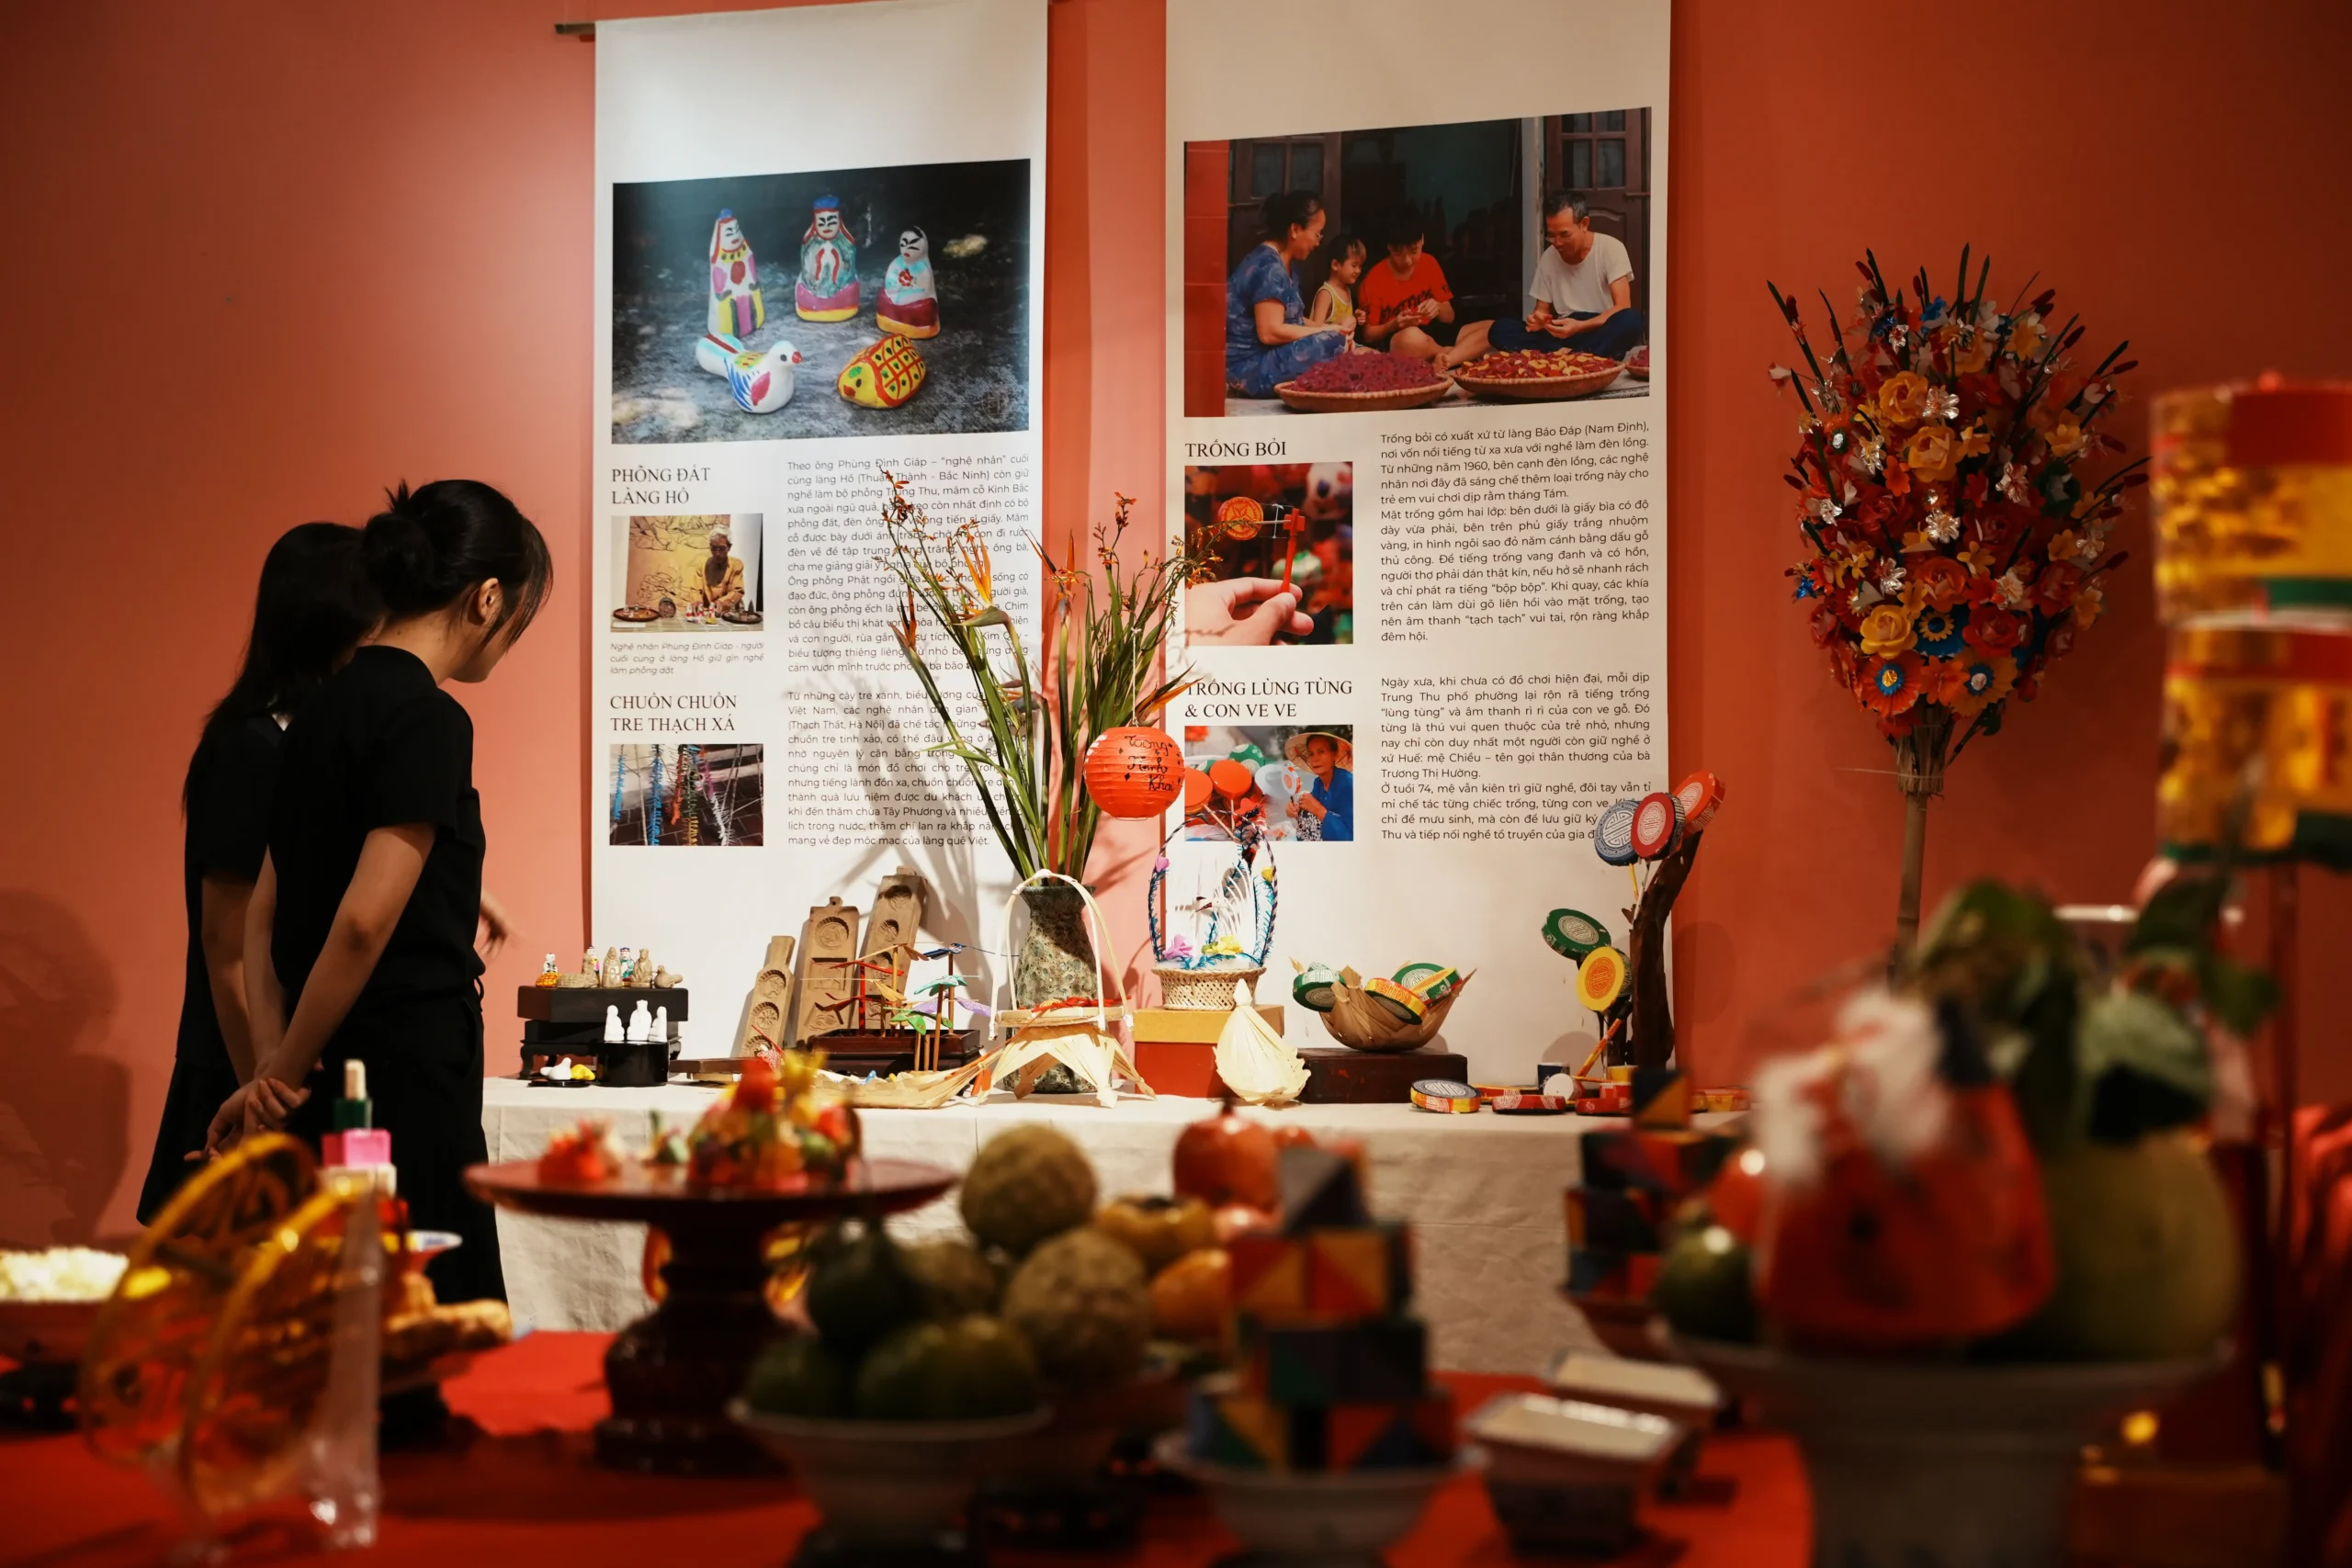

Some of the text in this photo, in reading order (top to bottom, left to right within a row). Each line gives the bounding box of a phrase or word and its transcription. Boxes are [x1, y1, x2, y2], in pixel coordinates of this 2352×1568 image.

[1380, 421, 1648, 445] Trống bỏi có xuất xứ từ làng Báo Đáp (Nam Định),
[1185, 437, 1286, 457] TRỐNG BỎI
[1381, 436, 1648, 458] nơi vốn nổi tiếng từ xa xưa với nghề làm đèn lồng.
[787, 461, 811, 470] Theo
[815, 461, 833, 471] ông
[838, 459, 871, 470] Phùng
[903, 457, 927, 468] Giáp
[1010, 454, 1029, 464] cuối
[1380, 452, 1648, 475] Từ những năm 1960, bên cạnh đèn lồng, các nghệ
[1381, 468, 1648, 489] nhân nơi đây đã sáng chế thêm loại trống này cho
[612, 487, 660, 504] LÀNG
[1380, 493, 1396, 504] trẻ
[1419, 492, 1434, 502] vui
[1437, 492, 1460, 502] chơi
[1463, 491, 1480, 503] dịp
[1484, 490, 1505, 501] rằm
[1508, 490, 1540, 501] tháng
[1544, 488, 1568, 498] Tám.
[1382, 608, 1649, 626] nên âm thanh “tạch tạch” vui tai, rộn ràng khắp
[1381, 631, 1428, 642] đêm hội.
[1185, 677, 1352, 696] TRỐNG LÙNG TÙNG
[1382, 671, 1649, 689] Ngày xưa, khi chưa có đồ chơi hiện đại, mỗi dịp
[610, 693, 736, 710] CHUỒN CHUỒN
[1381, 687, 1649, 704] Trung Thu phố phường lại rộn rã tiếng trống
[1185, 704, 1297, 717] & CON VE VE
[1381, 707, 1408, 719] “lùng
[1414, 706, 1444, 718] tùng”
[1448, 706, 1460, 716] và
[1465, 706, 1483, 716] âm
[1488, 705, 1520, 716] thanh
[1525, 705, 1532, 715] rì
[1537, 705, 1544, 715] rì
[1548, 704, 1567, 715] của
[1613, 703, 1630, 716] gỗ.
[1634, 704, 1650, 713] Đó
[610, 713, 736, 734] TRE THẠCH XÁ
